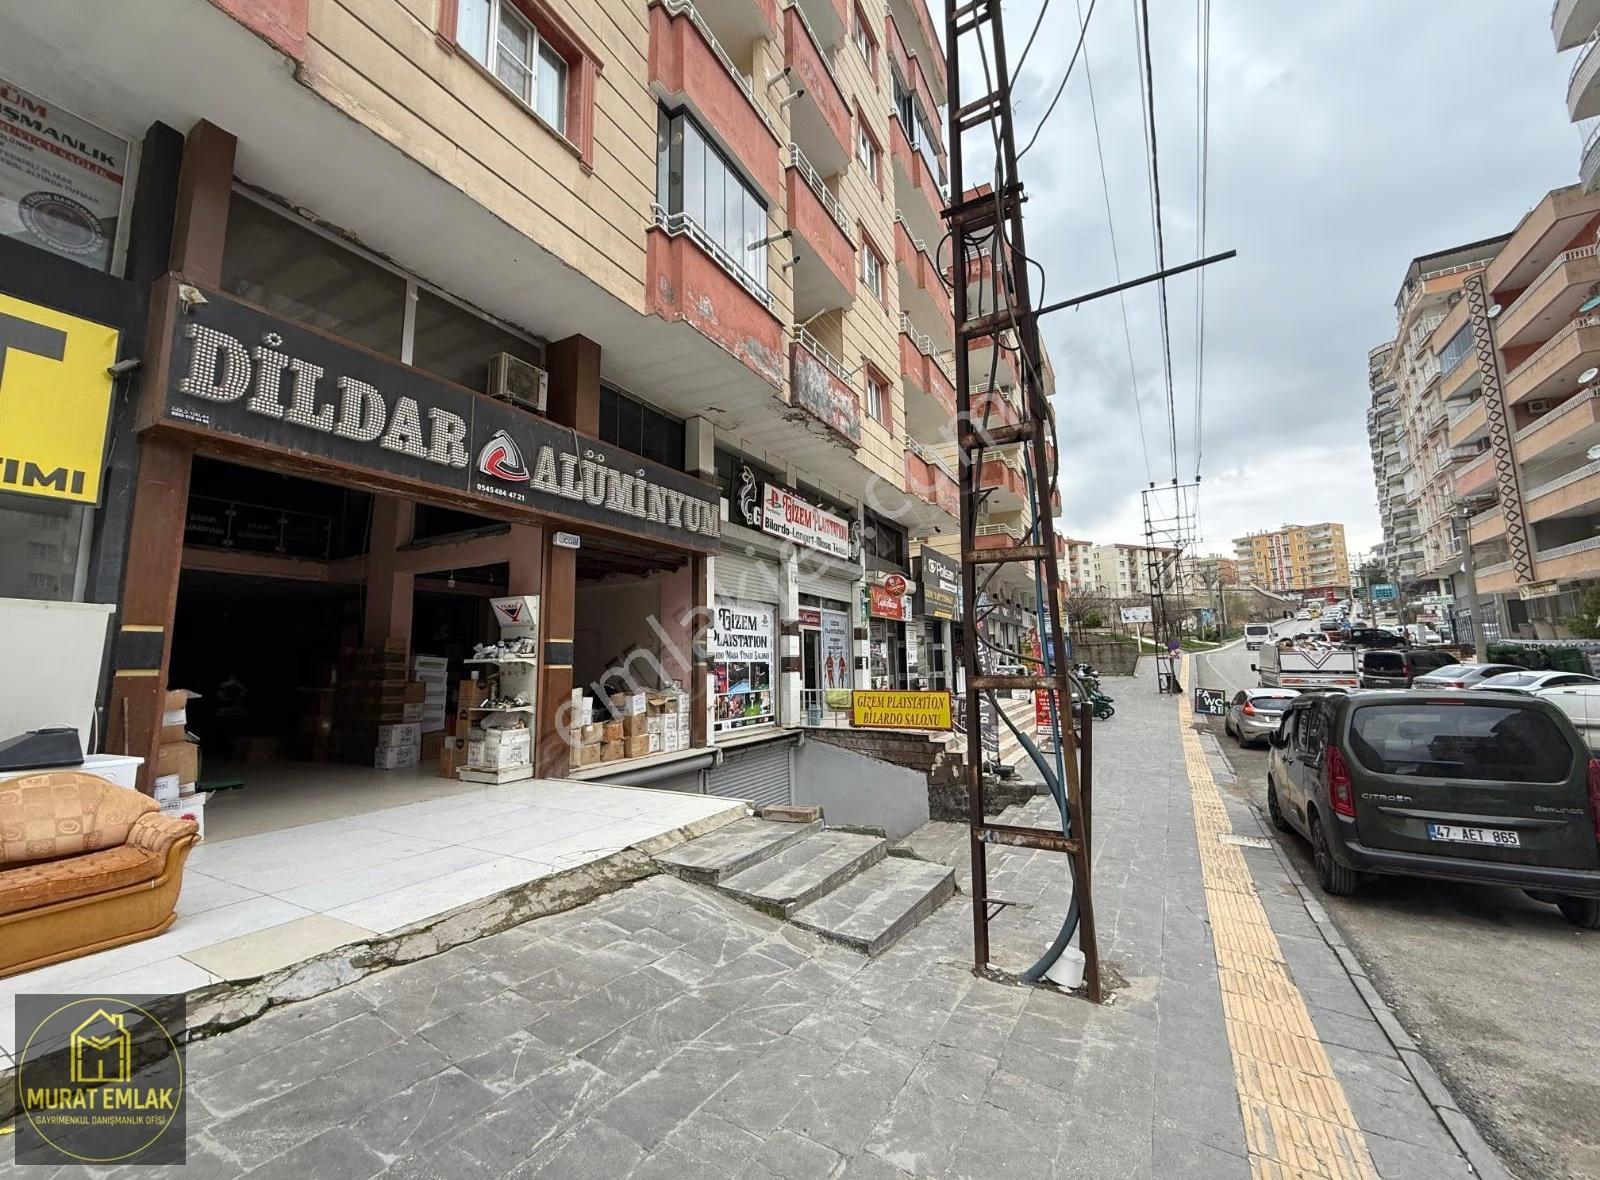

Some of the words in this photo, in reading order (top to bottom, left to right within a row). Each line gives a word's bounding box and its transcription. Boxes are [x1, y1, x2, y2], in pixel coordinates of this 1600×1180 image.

[0, 103, 116, 167] ŞMANLIK
[179, 322, 470, 469] DİLDAR
[530, 445, 721, 538] ALÜMİNYUM
[857, 693, 884, 711] GİZEM
[863, 712, 903, 725] BİLARDO
[905, 713, 941, 727] SALONU
[1437, 825, 1450, 837] 47
[1462, 828, 1483, 841] AET
[1492, 831, 1517, 844] 865
